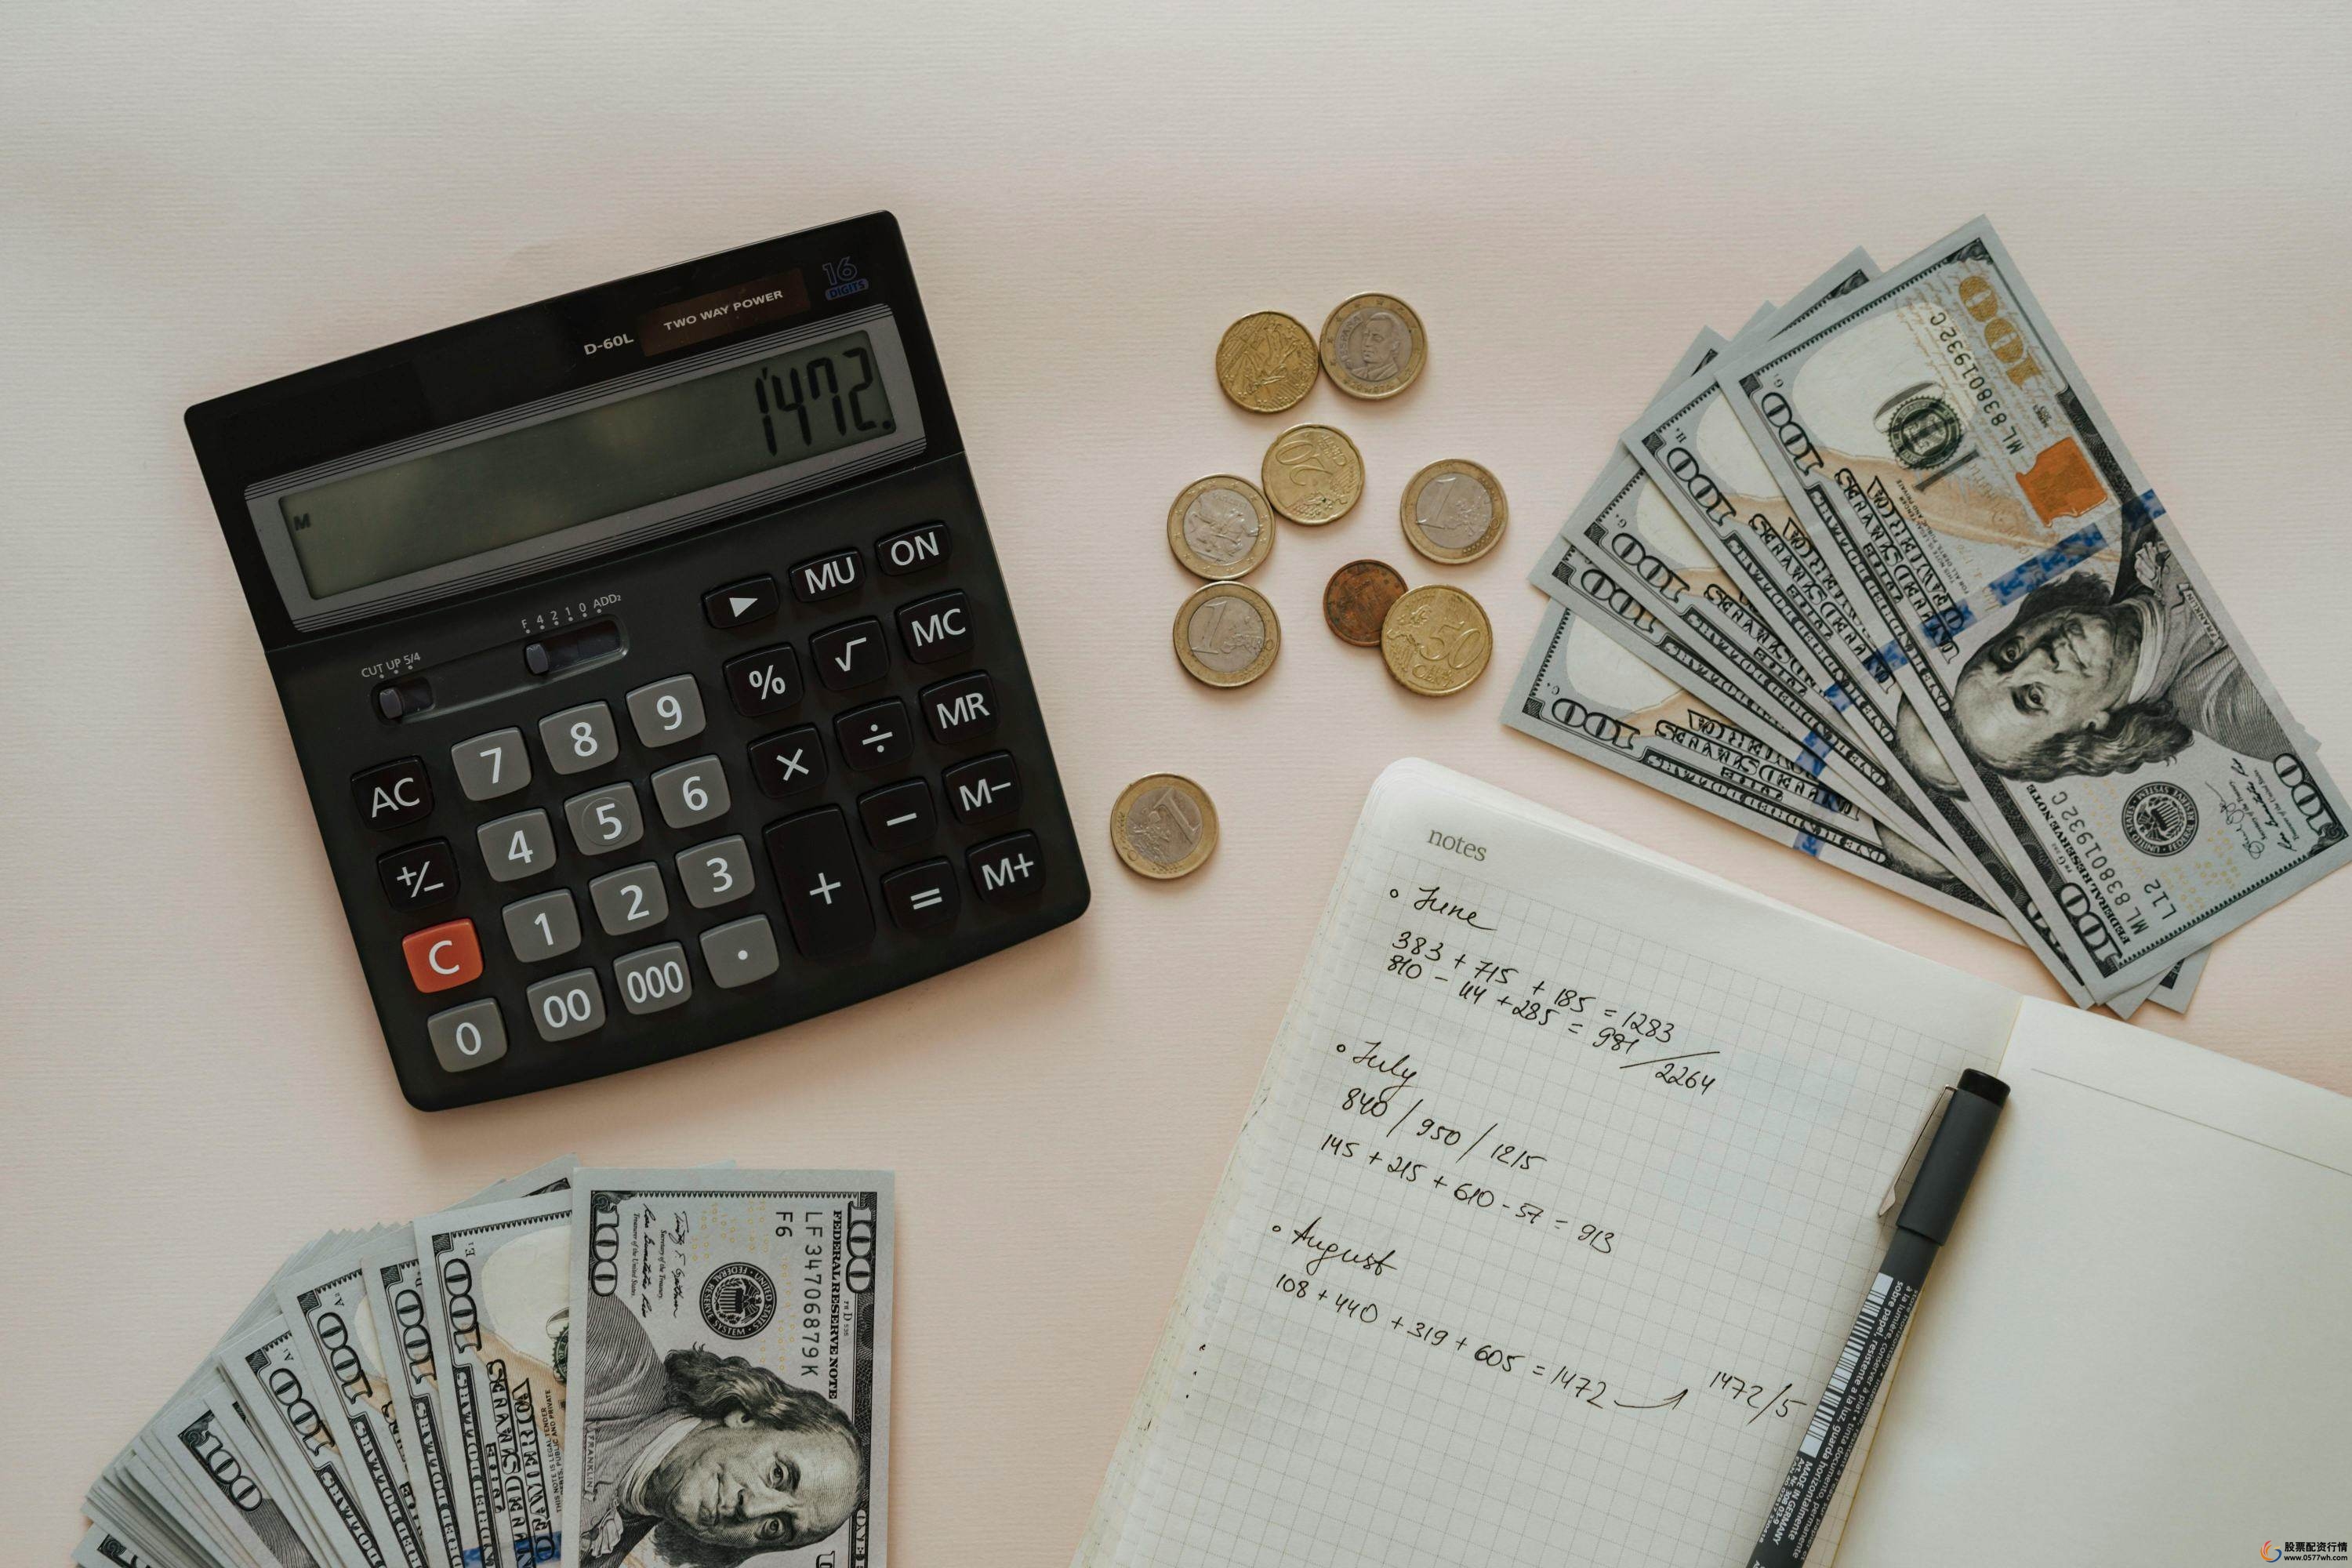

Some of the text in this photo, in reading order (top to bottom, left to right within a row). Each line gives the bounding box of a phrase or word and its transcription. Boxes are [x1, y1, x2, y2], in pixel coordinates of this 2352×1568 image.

[821, 255, 859, 287] 16
[827, 279, 866, 299] DIGITS
[664, 291, 782, 330] TWO WAY POWER
[1958, 276, 2045, 386] 100
[584, 334, 633, 354] D-60L
[1930, 313, 2024, 454] ML 83801932 C
[1759, 392, 1827, 476] 100
[1666, 448, 1738, 525] 100
[294, 514, 310, 531] M
[1829, 464, 1905, 567] STATES
[1858, 474, 1947, 597] AMERICA
[891, 532, 938, 565] ON
[1611, 534, 1690, 601] 100
[805, 557, 855, 593] MU
[521, 619, 527, 628] F
[550, 611, 557, 620] 2
[565, 607, 570, 615] 1
[579, 603, 586, 612] 0
[1805, 488, 1953, 713] ONE HUNDRED DOLLARS
[1889, 560, 1965, 663] UNITED
[1930, 587, 1969, 633] OF
[2183, 591, 2219, 639] FRANKLIN
[912, 608, 965, 646] MC
[361, 652, 420, 677] CUT UP 5/4
[657, 695, 682, 730] 9
[937, 693, 989, 728] MR
[1552, 699, 1640, 749] 100
[571, 722, 597, 757] 8
[481, 747, 501, 783] 7
[372, 778, 419, 818] AC
[683, 776, 708, 811] 6
[2274, 753, 2337, 833] 100
[597, 804, 622, 840] 5
[509, 830, 533, 863] 4
[1428, 830, 1486, 861] notes
[2027, 785, 2130, 944] FEDERAL RESERVE NOTE
[2052, 791, 2148, 935] ML 83801932 C
[707, 858, 732, 892] 3
[621, 885, 649, 920] 2
[1414, 887, 1493, 930] June
[2144, 879, 2176, 920] L12
[535, 913, 554, 945] 1
[2059, 883, 2125, 966] 100
[429, 941, 459, 974] C
[1388, 955, 1421, 978] 810
[1392, 931, 1443, 961] 383
[1475, 961, 1518, 984] 715
[1554, 989, 1595, 1012] 185
[627, 961, 683, 1003] 000
[544, 989, 590, 1028] 00
[456, 1022, 481, 1054] 0
[1348, 1042, 1417, 1107] July
[1655, 1063, 1715, 1094] 2264
[1341, 1086, 1390, 1122] 840
[1417, 1119, 1461, 1145] 950
[1491, 1144, 1547, 1170] 1215
[1321, 1134, 1359, 1157] 145
[1388, 1156, 1426, 1181] 215
[1454, 1183, 1494, 1207] 610
[1515, 1203, 1544, 1224] 57
[1578, 1225, 1614, 1254] 913
[775, 1211, 792, 1237] F6
[590, 1204, 621, 1298] 100
[845, 1202, 872, 1294] 100
[1291, 1217, 1396, 1276] August
[441, 1258, 485, 1352] 100
[702, 1266, 746, 1336] FEDERAL RESERVE SYSTEM
[753, 1272, 772, 1329] UNITED STATES
[800, 1212, 822, 1376] LF 34706879 K
[828, 1210, 841, 1399] FEDERAL RESERVE NOTE
[1889, 1281, 1903, 1307] sobre
[1902, 1294, 1909, 1302] la
[396, 1289, 437, 1382] 100
[1276, 1274, 1308, 1298] 108
[1336, 1294, 1377, 1323] 440
[1475, 1345, 1524, 1372] 605
[1874, 1308, 1891, 1336] papel,
[1884, 1305, 1905, 1339] lumière,
[318, 1312, 373, 1403] 100
[1855, 1340, 1878, 1385] resistente
[1867, 1343, 1887, 1385] conserver
[270, 1369, 336, 1455] 100
[1837, 1406, 1851, 1421] luz,
[1846, 1396, 1856, 1404] la
[1854, 1395, 1864, 1414] plat
[1823, 1425, 1841, 1459] guarda
[1841, 1424, 1853, 1444] tinta
[191, 1428, 261, 1512] 100
[586, 1434, 595, 1488] FRANKLIN
[1795, 1458, 1804, 1472] Art.
[1817, 1446, 1843, 1499] documento,
[1773, 1461, 1813, 1544] MADE IN GERMANY
[1773, 1506, 1784, 1524] 03-9
[1782, 1491, 1791, 1504] 308
[1788, 1461, 1828, 1540] horizontalmente
[1793, 1501, 1819, 1558] permanente
